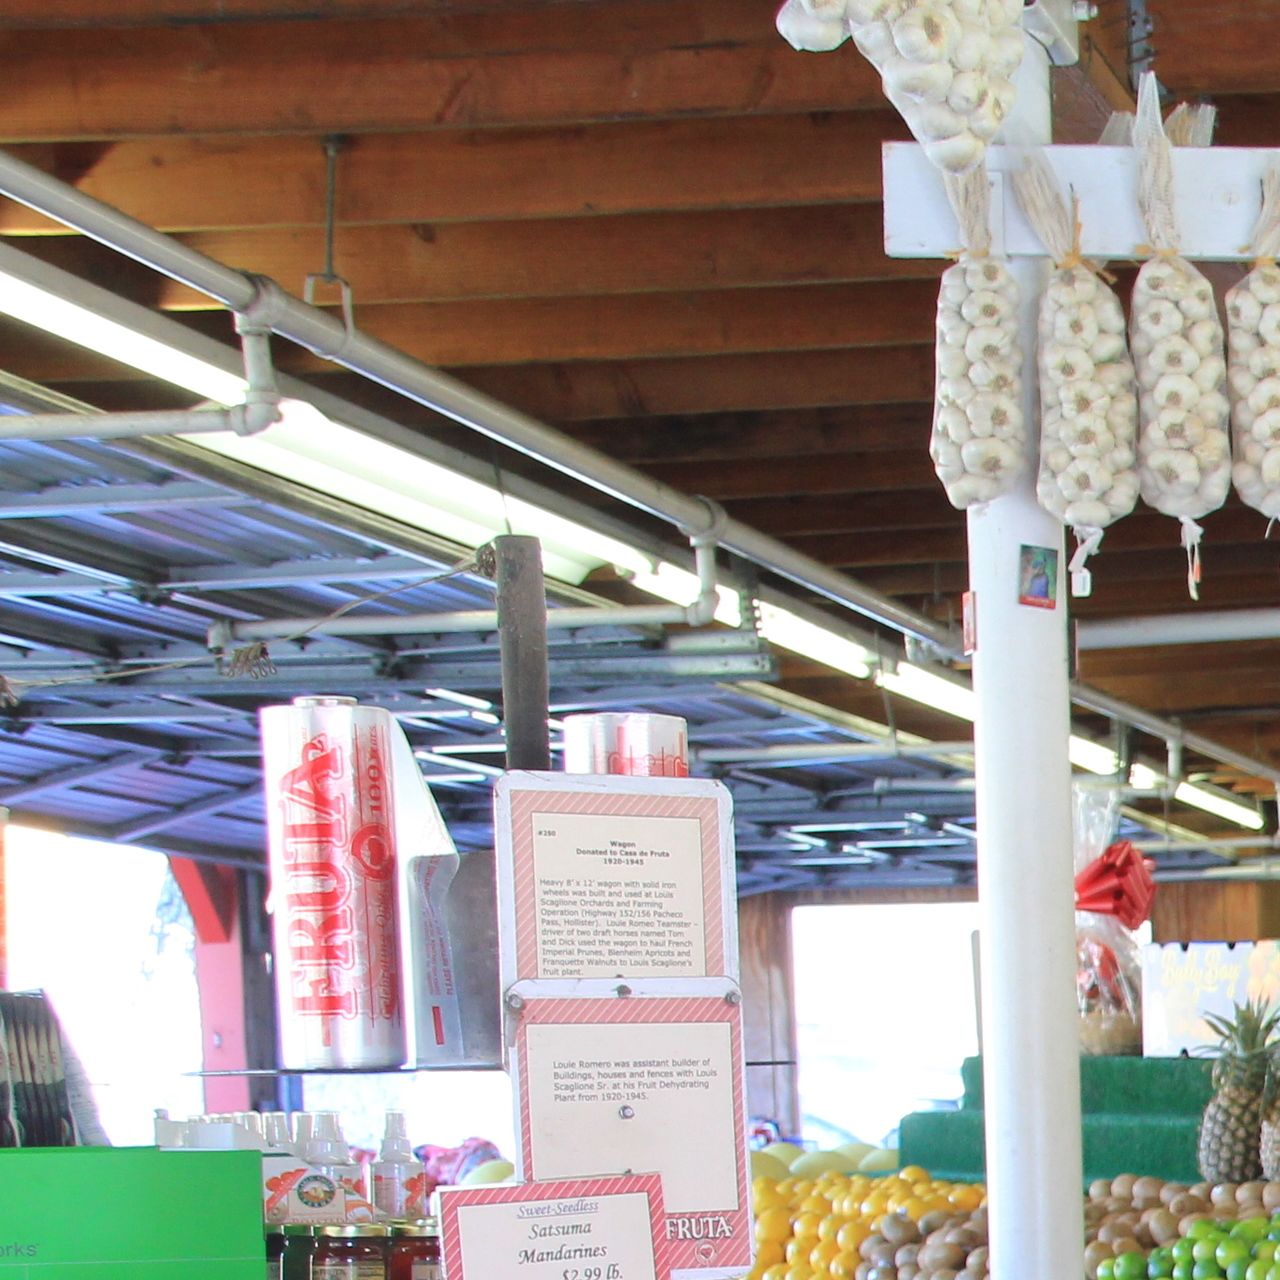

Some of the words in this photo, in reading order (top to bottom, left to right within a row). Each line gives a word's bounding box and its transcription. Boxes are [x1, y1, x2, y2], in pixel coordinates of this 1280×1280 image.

[367, 765, 382, 815] 100
[610, 840, 635, 850] Wagon
[649, 850, 669, 858] Fruta
[603, 858, 644, 866] 1920-1945
[280, 732, 357, 1020] FRUTA
[540, 879, 564, 888] Heavy
[596, 881, 622, 889] wagon
[624, 890, 642, 898] used
[540, 899, 578, 908] Scaglione
[632, 900, 663, 909] Farming
[541, 909, 579, 918] Operation
[580, 910, 617, 919] (Highway
[576, 929, 591, 937] two
[542, 949, 574, 957] Imperial
[643, 950, 675, 958] Apricots
[543, 959, 584, 967] Franquette
[628, 959, 649, 967] Louis
[553, 1061, 576, 1069] Louie
[671, 1059, 700, 1067] builder
[596, 1071, 626, 1079] houses
[646, 1070, 673, 1078] fences
[554, 1083, 594, 1092] Scaglione
[659, 1081, 709, 1090] Dehydrating
[554, 1094, 576, 1102] Plant
[516, 1200, 599, 1218] Sweet-Seedless
[528, 1223, 592, 1240] Satsuma
[665, 1216, 732, 1240] FRUTA
[518, 1244, 607, 1264] Mandarines
[606, 1264, 623, 1280] lb.
